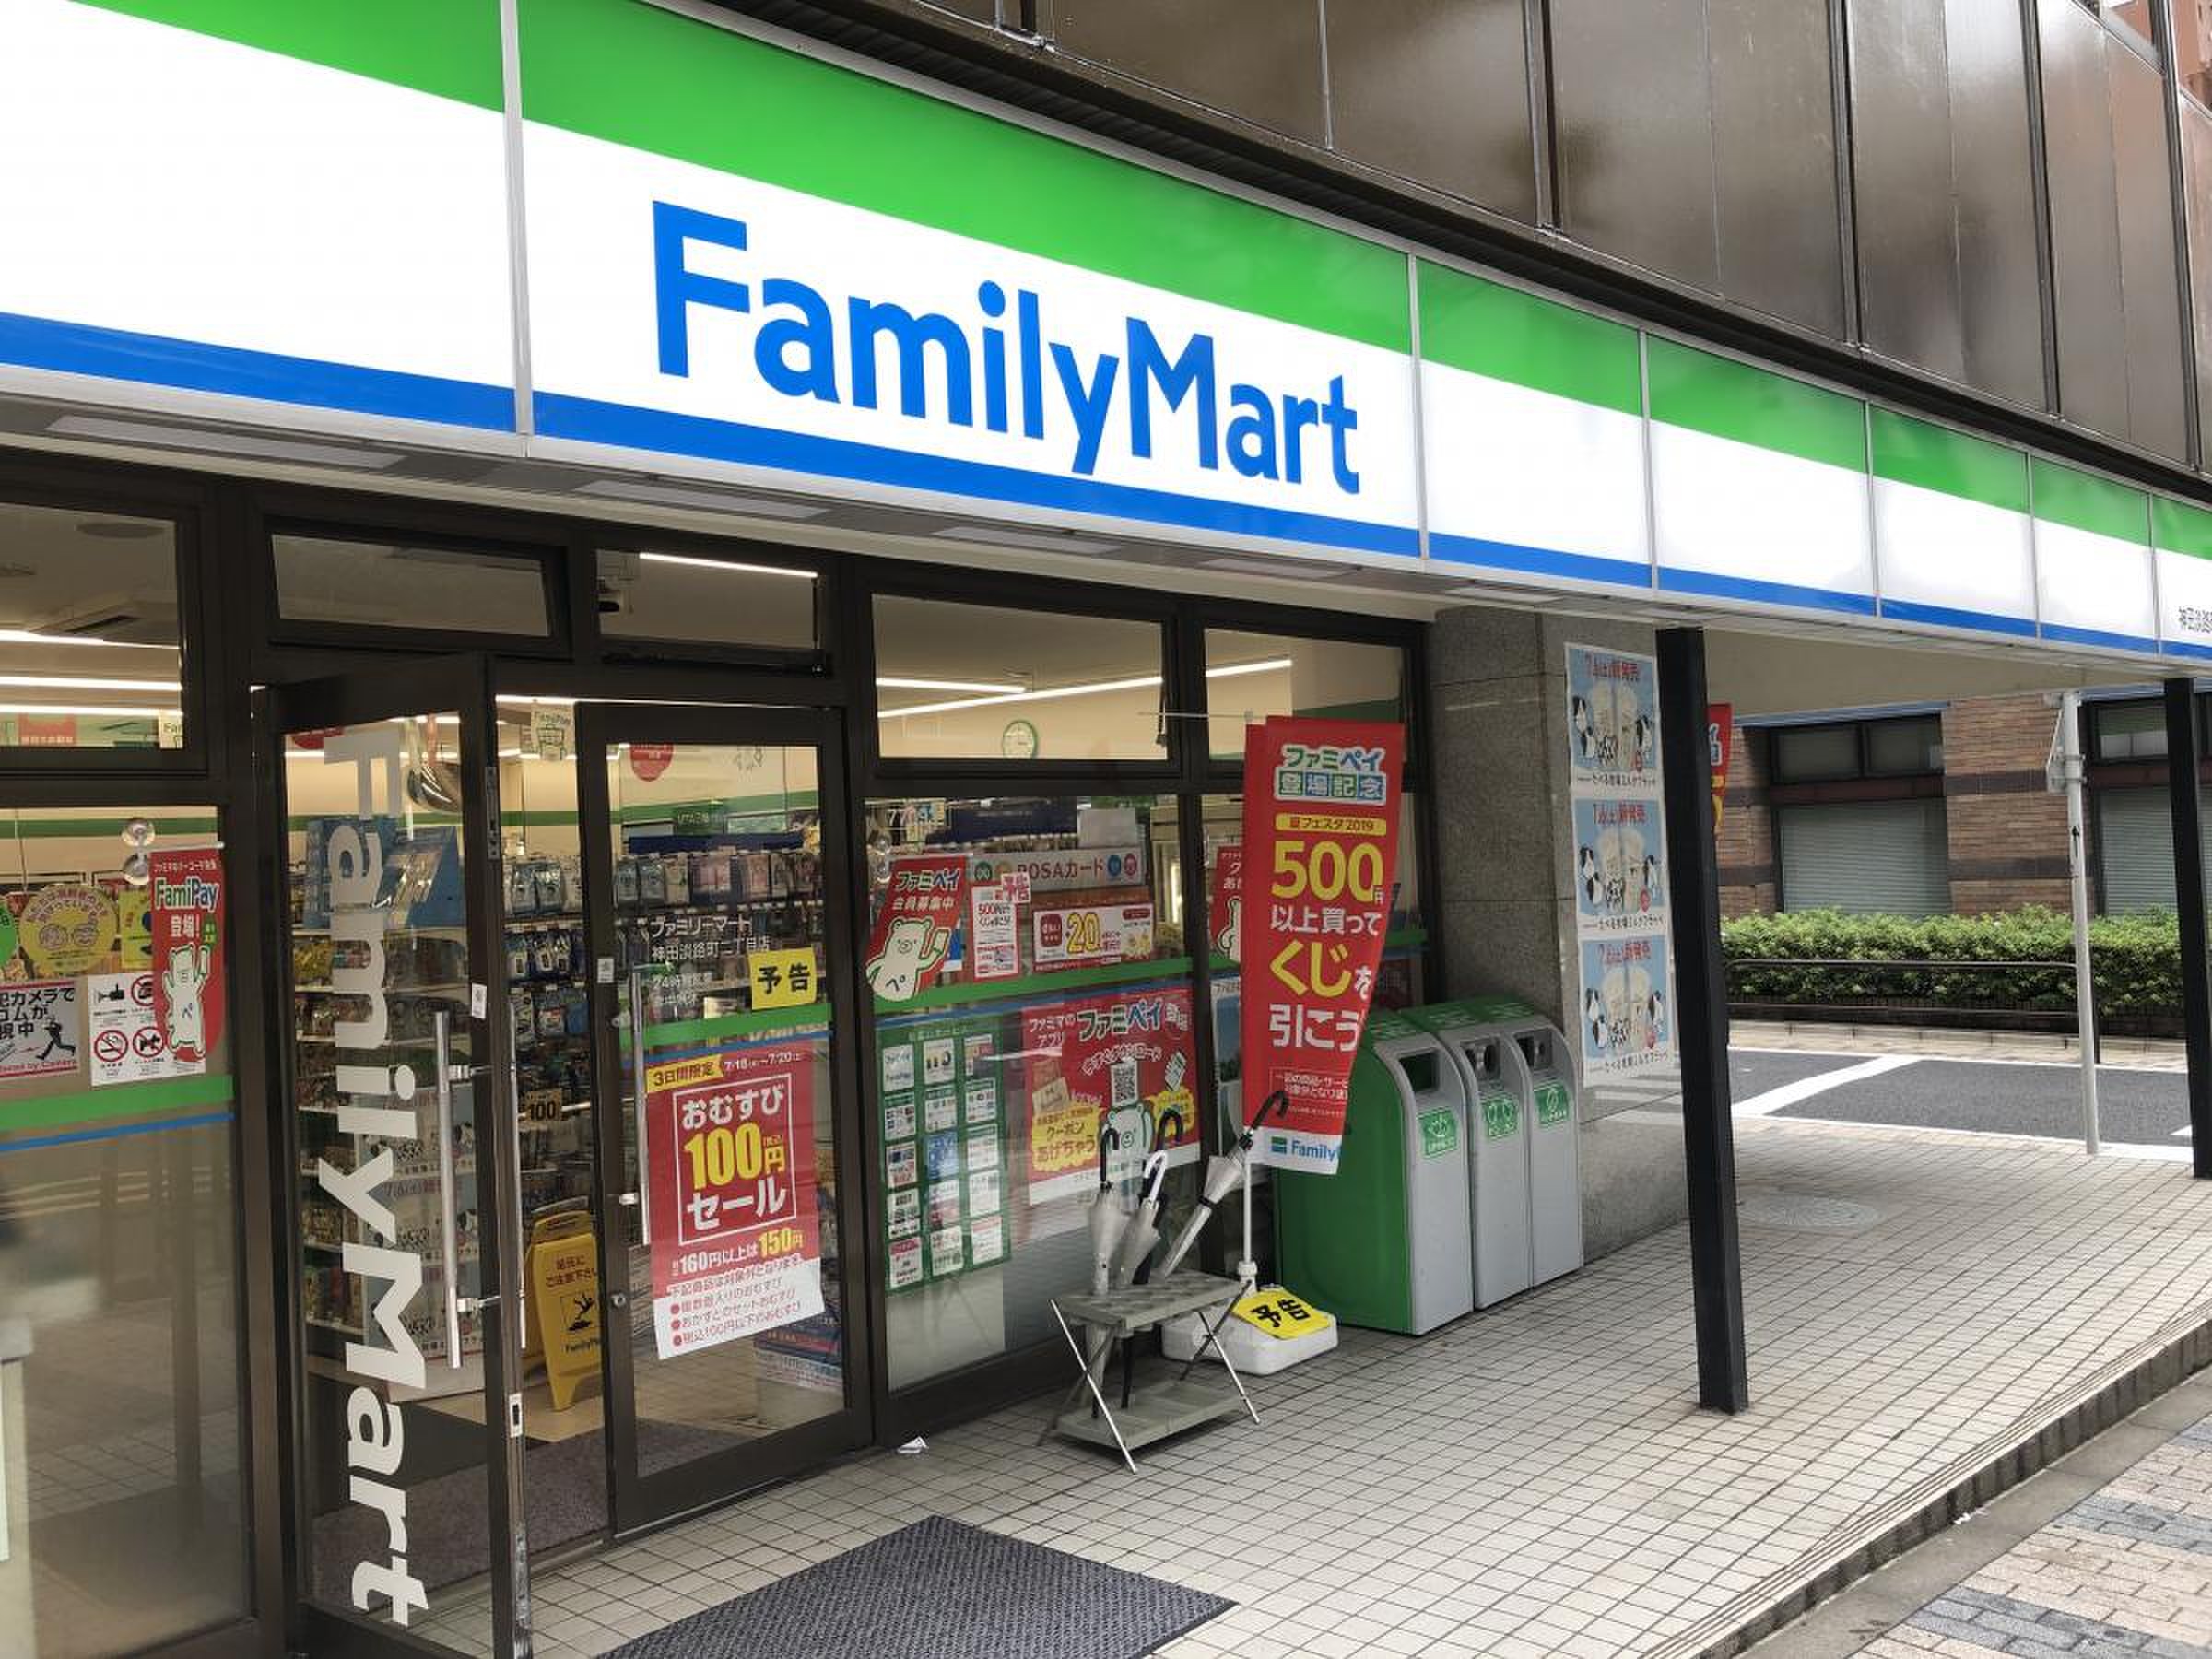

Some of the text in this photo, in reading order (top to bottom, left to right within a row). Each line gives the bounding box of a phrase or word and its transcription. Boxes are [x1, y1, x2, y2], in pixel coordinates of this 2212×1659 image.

[653, 200, 1359, 494] FamilyMart
[1285, 747, 1384, 771] ファミペイ
[1278, 772, 1383, 800] 登場記念
[155, 877, 219, 912] FamiPay
[894, 867, 959, 892] ファミペイ
[650, 914, 753, 938] ファミリーマート
[1271, 906, 1381, 936] 以上買って
[758, 963, 811, 994] 予告
[1269, 940, 1372, 1000] くじを
[1077, 998, 1163, 1042] ファミペイ
[1269, 1005, 1360, 1049] 引こう
[653, 1061, 715, 1086] 3日間限定
[682, 1082, 784, 1130] おむすび
[1047, 1121, 1085, 1139] クーポン
[1292, 1139, 1338, 1162] Family
[318, 736, 429, 1628] FamilyMart
[688, 1179, 786, 1231] セール
[1250, 1299, 1311, 1328] 予告
